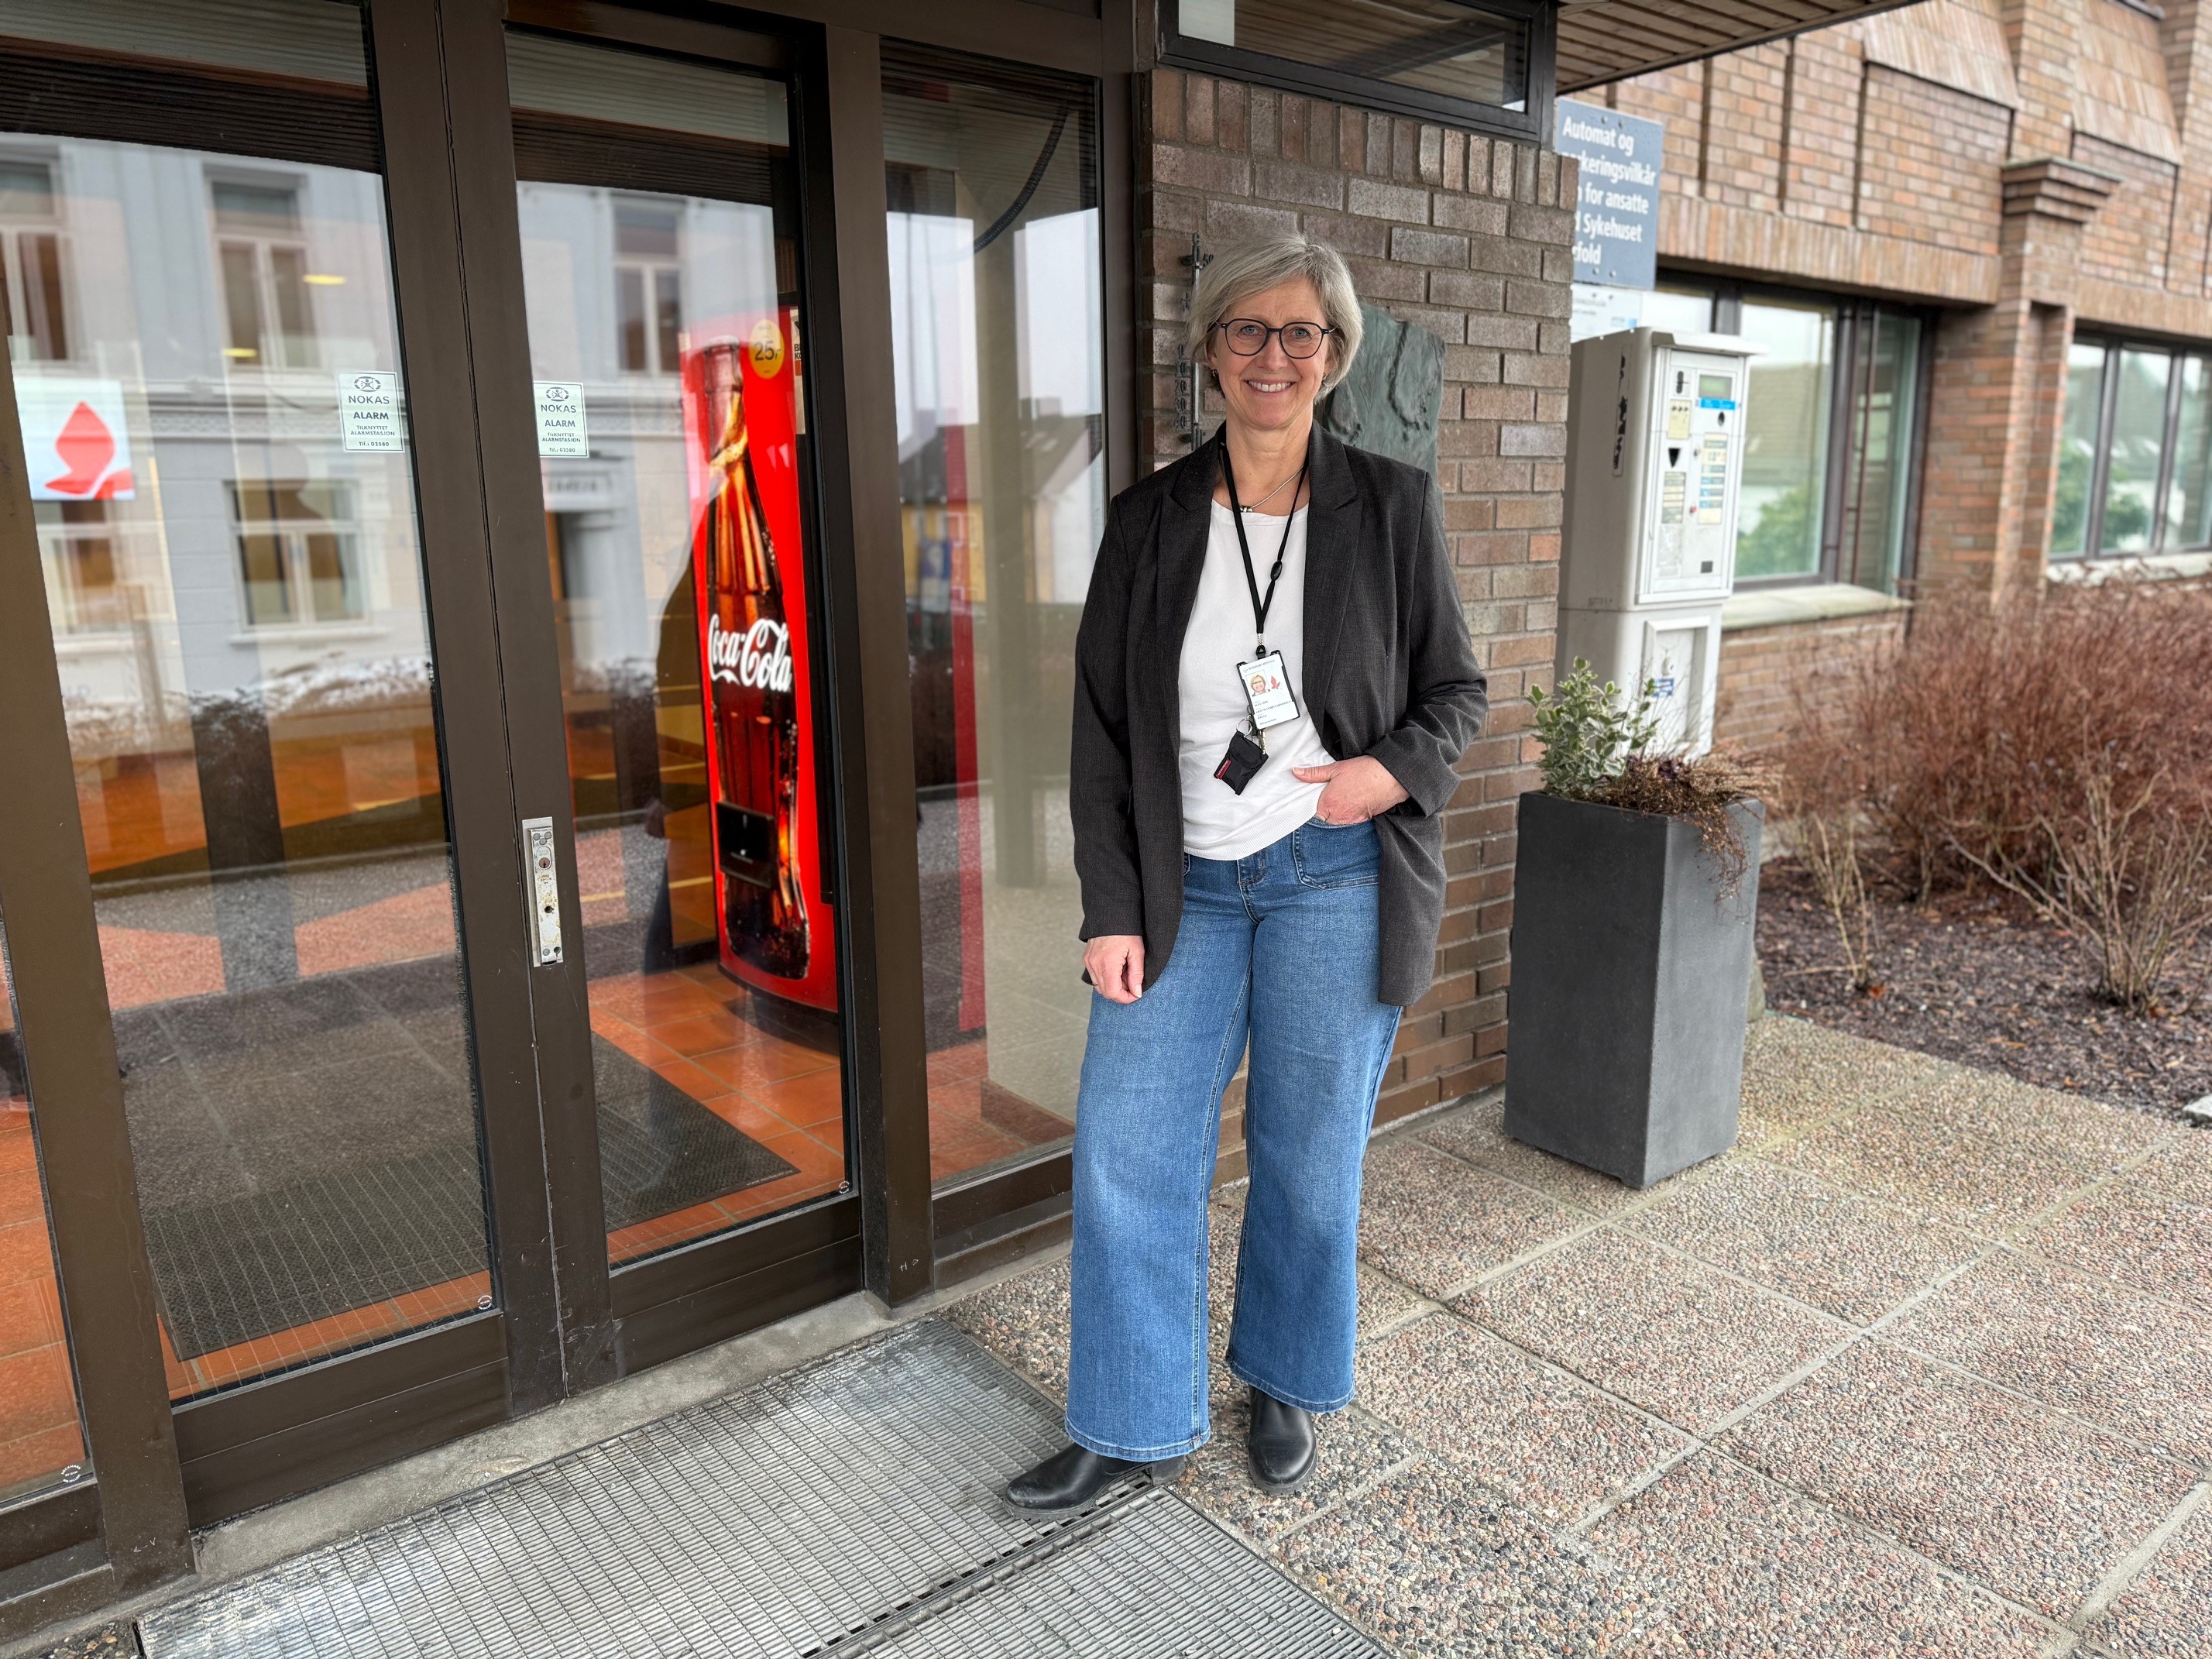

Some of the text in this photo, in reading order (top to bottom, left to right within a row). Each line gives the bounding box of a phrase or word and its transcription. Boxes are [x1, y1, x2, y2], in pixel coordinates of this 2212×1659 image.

[1562, 115, 1634, 157] Automat og
[1561, 149, 1657, 187] keringsvilkår
[1585, 181, 1604, 205] for
[1605, 191, 1650, 215] ansatte
[1583, 213, 1643, 242] Sykehuset
[349, 395, 390, 404] NOKAS
[541, 404, 576, 413] NOKAS
[353, 411, 389, 420] ALARM
[544, 419, 575, 428] ALARM
[708, 613, 792, 692] Coca-Cola
